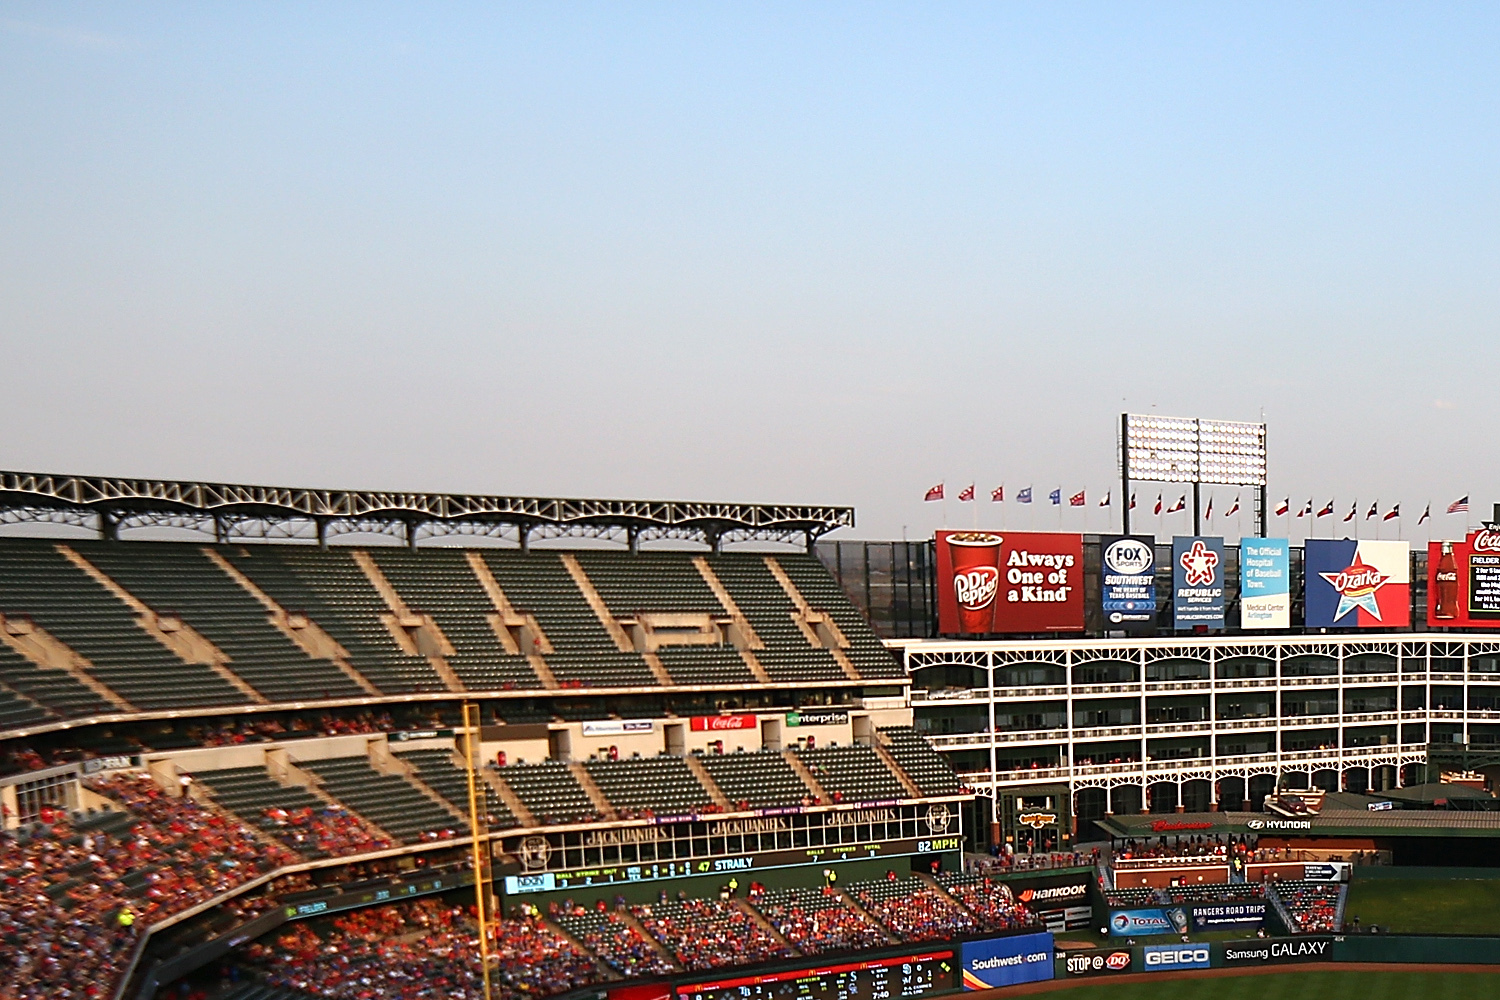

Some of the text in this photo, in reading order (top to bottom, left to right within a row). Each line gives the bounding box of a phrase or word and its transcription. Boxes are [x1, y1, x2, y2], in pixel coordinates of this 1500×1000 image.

[1116, 547, 1142, 560] FOX
[1247, 547, 1281, 556] The Official
[1007, 550, 1074, 570] Always
[1247, 559, 1273, 567] Hospital
[1007, 568, 1067, 584] One of
[1246, 569, 1282, 577] of Baseball
[968, 572, 989, 588] Dr
[1104, 575, 1154, 586] SOUTHWEST
[1247, 580, 1265, 588] Town.
[1335, 570, 1381, 592] Ozarka
[954, 574, 996, 605] Pepper
[1007, 590, 1019, 602] a
[1177, 589, 1222, 597] REPUBLIC
[788, 713, 848, 723] enterprise
[827, 812, 855, 825] JACK
[1266, 820, 1311, 829] HYUNDAI
[712, 820, 741, 835] JACK
[586, 831, 618, 846] JACK
[918, 838, 958, 852] 82 MPH
[698, 857, 753, 873] 47 STRAILY
[1031, 884, 1087, 900] HANKOOK
[1193, 905, 1266, 916] RANGERS ROAD TRIPS
[1131, 916, 1168, 925] TOTAL
[1145, 949, 1210, 965] GEICO
[1226, 941, 1327, 960] Samsung GALAXY
[1067, 956, 1129, 972] STOP @ DQ
[755, 986, 762, 994] 2
[872, 991, 890, 1000] 7:40
